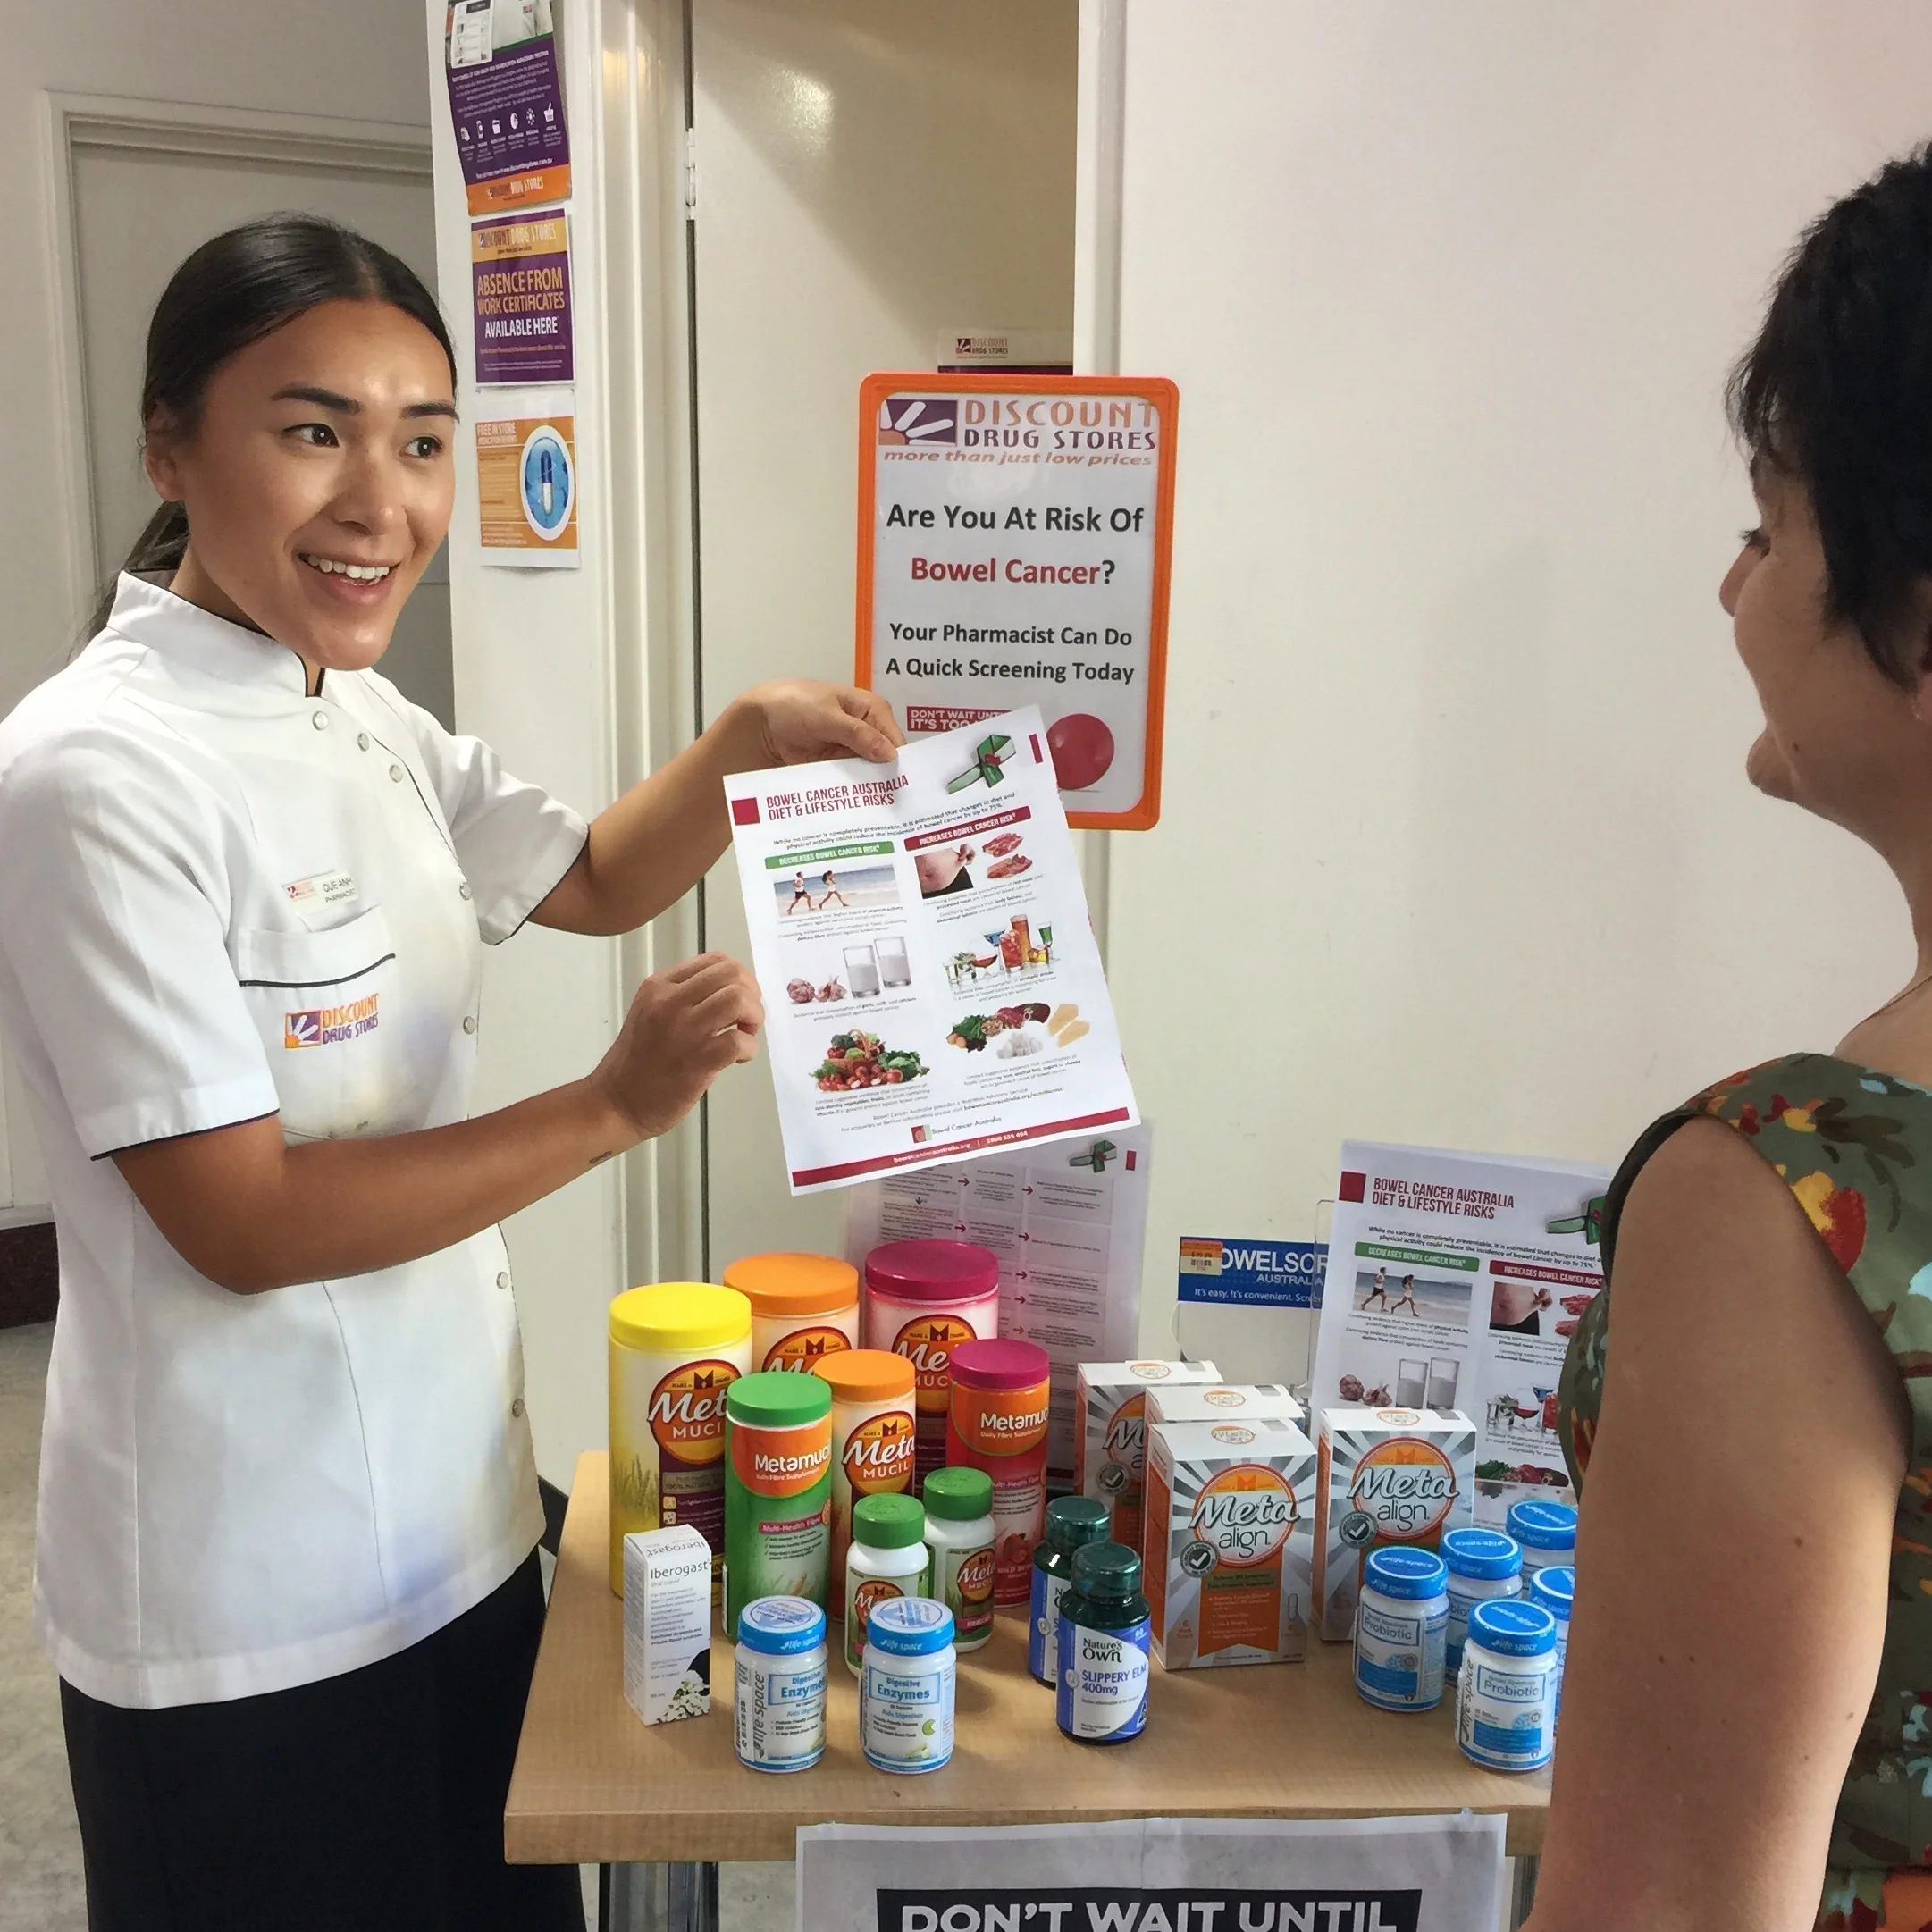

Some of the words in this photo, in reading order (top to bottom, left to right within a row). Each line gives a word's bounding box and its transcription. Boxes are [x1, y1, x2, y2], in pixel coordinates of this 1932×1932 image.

[531, 223, 556, 242] STORES
[477, 270, 525, 296] ABSENCE
[527, 267, 563, 291] FROM
[477, 297, 501, 315] WORK
[502, 292, 565, 313] CERTIFICATES
[485, 318, 532, 338] AVAILABLE
[533, 317, 558, 335] HERE
[971, 337, 1007, 347] DISCOUNT
[964, 399, 1155, 428] DISCOUNT
[477, 424, 491, 435] FREE
[964, 429, 1040, 448] DRUG
[1054, 430, 1156, 450] STORES
[884, 451, 940, 462] more
[945, 449, 995, 463] than
[998, 451, 1041, 466] just
[1045, 452, 1084, 465] low
[1088, 453, 1153, 467] prices
[886, 504, 935, 528] Are
[943, 505, 995, 529] You
[1004, 507, 1037, 530] At
[1046, 507, 1102, 532] Risk
[1110, 508, 1144, 533] Of
[911, 558, 995, 582] Bowel
[1005, 559, 1116, 584] Cancer?
[890, 623, 937, 641] Your
[943, 624, 1054, 644] Pharmacist
[1061, 627, 1097, 645] Can
[1105, 628, 1132, 646] Do
[886, 659, 900, 675] A
[906, 659, 962, 678] Quick
[969, 659, 1066, 683] Screening
[1072, 663, 1134, 685] Today
[911, 710, 945, 718] DON'T
[947, 710, 976, 719] WAIT
[911, 719, 937, 729] IT'S
[766, 792, 804, 809] BOWEL
[806, 785, 849, 802] CANCER
[852, 775, 909, 796] AUSTRALIA
[769, 806, 794, 821] DIET
[795, 804, 803, 817] &
[805, 796, 861, 815] LIFESTYLE
[863, 794, 895, 808] RISKS
[829, 827, 863, 836] completely
[915, 813, 945, 824] estimated
[959, 802, 982, 813] changes
[1004, 793, 1015, 801] and
[787, 841, 811, 850] physical
[812, 837, 834, 845] activity
[924, 819, 943, 828] bowel
[944, 815, 962, 824] cancer
[919, 832, 953, 845] INCREASES
[953, 826, 974, 837] BOWEL
[975, 819, 998, 830] CANCER
[778, 853, 815, 865] DECREASES
[815, 850, 837, 859] BOWEL
[837, 847, 862, 857] CANCER
[323, 994, 379, 1028] DISCOUNT
[323, 1024, 352, 1045] DRUG
[355, 1012, 379, 1037] STORES
[932, 1124, 950, 1135] Bowel
[952, 1121, 972, 1130] Cancer
[974, 1116, 1002, 1127] Australia
[1373, 1177, 1411, 1195] BOWEL
[1412, 1182, 1454, 1200] CANCER
[1457, 1188, 1515, 1208] AUSTRALIA
[1373, 1191, 1397, 1206] DIET
[1398, 1194, 1406, 1207] &
[1407, 1195, 1462, 1215] LIFESTYLE
[1464, 1204, 1495, 1220] RISKS
[1404, 1238, 1424, 1246] activity
[1422, 1233, 1455, 1242] completely
[1506, 1246, 1536, 1254] estimated
[1550, 1250, 1575, 1259] changes
[1368, 1247, 1402, 1259] DECREASES
[1403, 1252, 1423, 1262] BOWEL
[1424, 1255, 1449, 1264] CANCER
[1256, 1273, 1323, 1286] AUSTRALA
[1504, 1265, 1537, 1277] INCREASES
[1538, 1271, 1558, 1280] BOWEL
[1559, 1273, 1584, 1283] CANCER
[1208, 1290, 1229, 1299] easy.
[1231, 1289, 1243, 1298] It's
[1244, 1292, 1293, 1301] convenient.
[897, 1341, 950, 1372] Me
[647, 1390, 727, 1423] Met
[673, 1422, 721, 1439] MUCI
[843, 1434, 915, 1466] Meta
[786, 1466, 820, 1480] Supplement
[863, 1462, 909, 1479] MUCIL
[1347, 1466, 1460, 1500] Meta
[1188, 1494, 1301, 1530] Meta
[762, 1522, 805, 1533] Multi-Health
[646, 1541, 705, 1558] Iberogast
[651, 1561, 709, 1579] Iberogast
[1365, 1616, 1412, 1640] Probiotic
[1083, 1638, 1122, 1651] Nature's
[1514, 1642, 1537, 1651] space
[1082, 1648, 1122, 1663] Own
[792, 1671, 821, 1684] Digestive
[886, 1677, 920, 1688] Digestive
[1082, 1669, 1130, 1684] SLIPPERY
[1132, 1663, 1147, 1678] ELM
[781, 1677, 827, 1699] Enzymes
[878, 1684, 930, 1701] Enzymes
[1082, 1683, 1118, 1695] 400mg
[1484, 1681, 1539, 1697] Probiotic
[902, 1902, 1073, 1932] DON'T
[1086, 1902, 1225, 1932] WAIT
[1239, 1901, 1398, 1932] UNTIL
